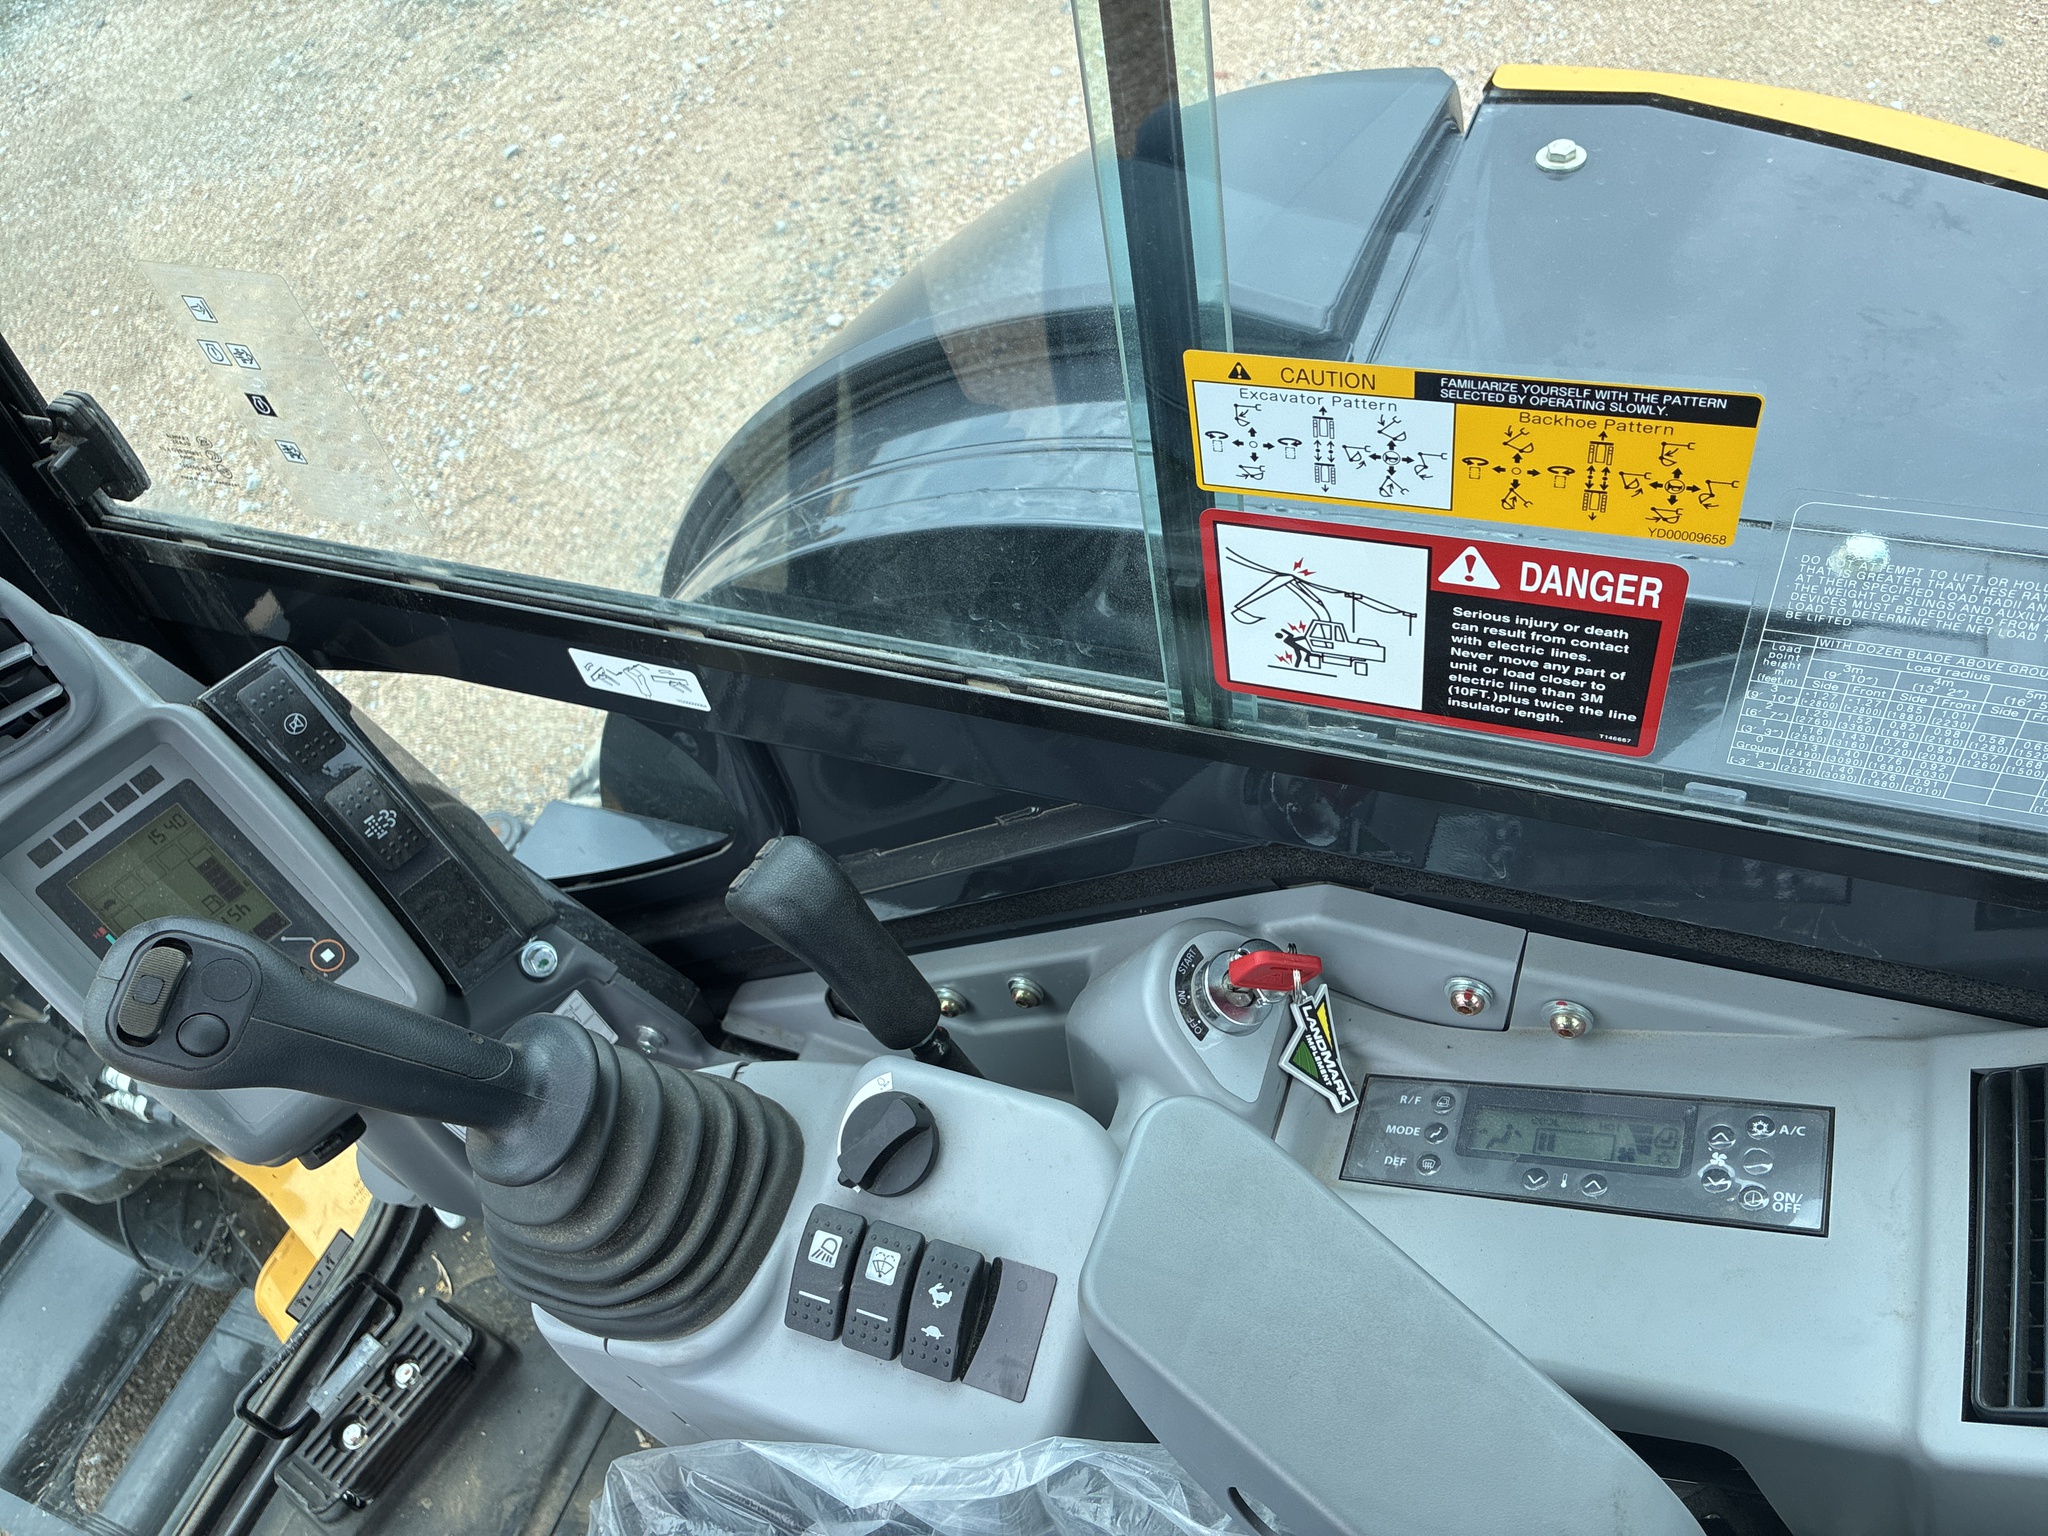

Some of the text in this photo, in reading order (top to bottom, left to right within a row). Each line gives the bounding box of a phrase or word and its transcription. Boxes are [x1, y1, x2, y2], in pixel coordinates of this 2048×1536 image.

[1280, 367, 1375, 391] CAUTION
[1441, 377, 1727, 409] FAMILIARIZE YOURSELF WITH THE PATTERN
[1239, 388, 1397, 412] Excavator Pattern
[1440, 388, 1668, 416] SELECTED BY OPERATING SLOWLY.
[1519, 411, 1674, 436] Backhoe Pattern
[1648, 527, 1727, 545] YD00009658
[1801, 554, 2009, 587] DO NOT ATTEMPT TO LIFT OR
[1520, 561, 1663, 609] DANGER
[1800, 564, 2018, 599] THAT IS GREATER THAN THESE
[1795, 573, 2022, 609] AT THEIR SPECIFIED LOAD RADII
[1794, 582, 1991, 615] THE WEIGHT OF SLINGS AND
[1785, 610, 1857, 627] BE LIFTED.
[1790, 592, 2040, 632] DEVICES MUST BE DEDUCTED FROM
[1453, 607, 1629, 640] Serious injury or death
[1788, 601, 2037, 641] LOAD TO DETERMINE THE NET LOAD
[1452, 622, 1630, 654] can result from contact
[1451, 635, 1591, 662] with electric lines.
[1772, 642, 1802, 654] Load
[1819, 638, 2006, 671] WITH DOZER BLADE ABOVE
[1450, 647, 1626, 681] Never move any part of
[1768, 652, 1801, 663] point
[1763, 658, 1802, 671] height
[1843, 664, 1864, 675] 3m
[1450, 661, 1606, 691] unit or load closer to
[1906, 662, 1991, 682] Load radius
[1449, 674, 1603, 704] electric line than 3M
[1770, 685, 1779, 693] 3
[1933, 677, 1954, 688] 4m
[1812, 680, 2019, 717] Side Front Side Front Side
[2025, 690, 2048, 701] 5m
[1448, 685, 1637, 722] (10FT.)plus twice the line
[1448, 697, 1564, 723] insulator length.
[1765, 702, 1774, 710] 2
[1896, 703, 1923, 714] 0.85
[1805, 708, 1829, 719] 1.25
[1848, 715, 1873, 725] 1.52
[1886, 711, 1926, 724] (1880)
[1942, 710, 1967, 721] 1.01
[1800, 725, 1824, 736] 1.16
[1889, 720, 1917, 732] 0.82
[1931, 717, 1971, 731] (2230)
[1756, 735, 1764, 743] 0
[1842, 731, 1866, 742] 1.43
[1933, 727, 1963, 739] 0.98
[1978, 733, 2008, 745] 0.58
[1735, 740, 1779, 754] Ground
[1794, 742, 1818, 752] 1.13
[1883, 737, 1910, 749] 0.78
[1836, 748, 1860, 759] 1.40
[1926, 744, 1955, 756] 0.94
[1970, 750, 2000, 762] 0.57
[1789, 758, 1812, 768] 1.14
[1877, 754, 1903, 766] 0.76
[1919, 761, 1948, 772] 0.92
[1830, 764, 1854, 775] 1.40
[1870, 770, 1896, 782] 0.76
[1913, 777, 1941, 788] 0.91
[1178, 949, 1197, 974] START
[1179, 991, 1186, 1004] ON
[1186, 1017, 1202, 1035] OFF
[1302, 1005, 1351, 1103] LANDMARK
[1305, 1035, 1332, 1086] IMPLEMENT
[1400, 1095, 1422, 1105] R/F
[1385, 1125, 1421, 1137] MODE
[1779, 1126, 1806, 1137] A/C
[1383, 1156, 1406, 1167] DEF
[1773, 1191, 1803, 1204] ON/
[1773, 1201, 1801, 1214] OFF
